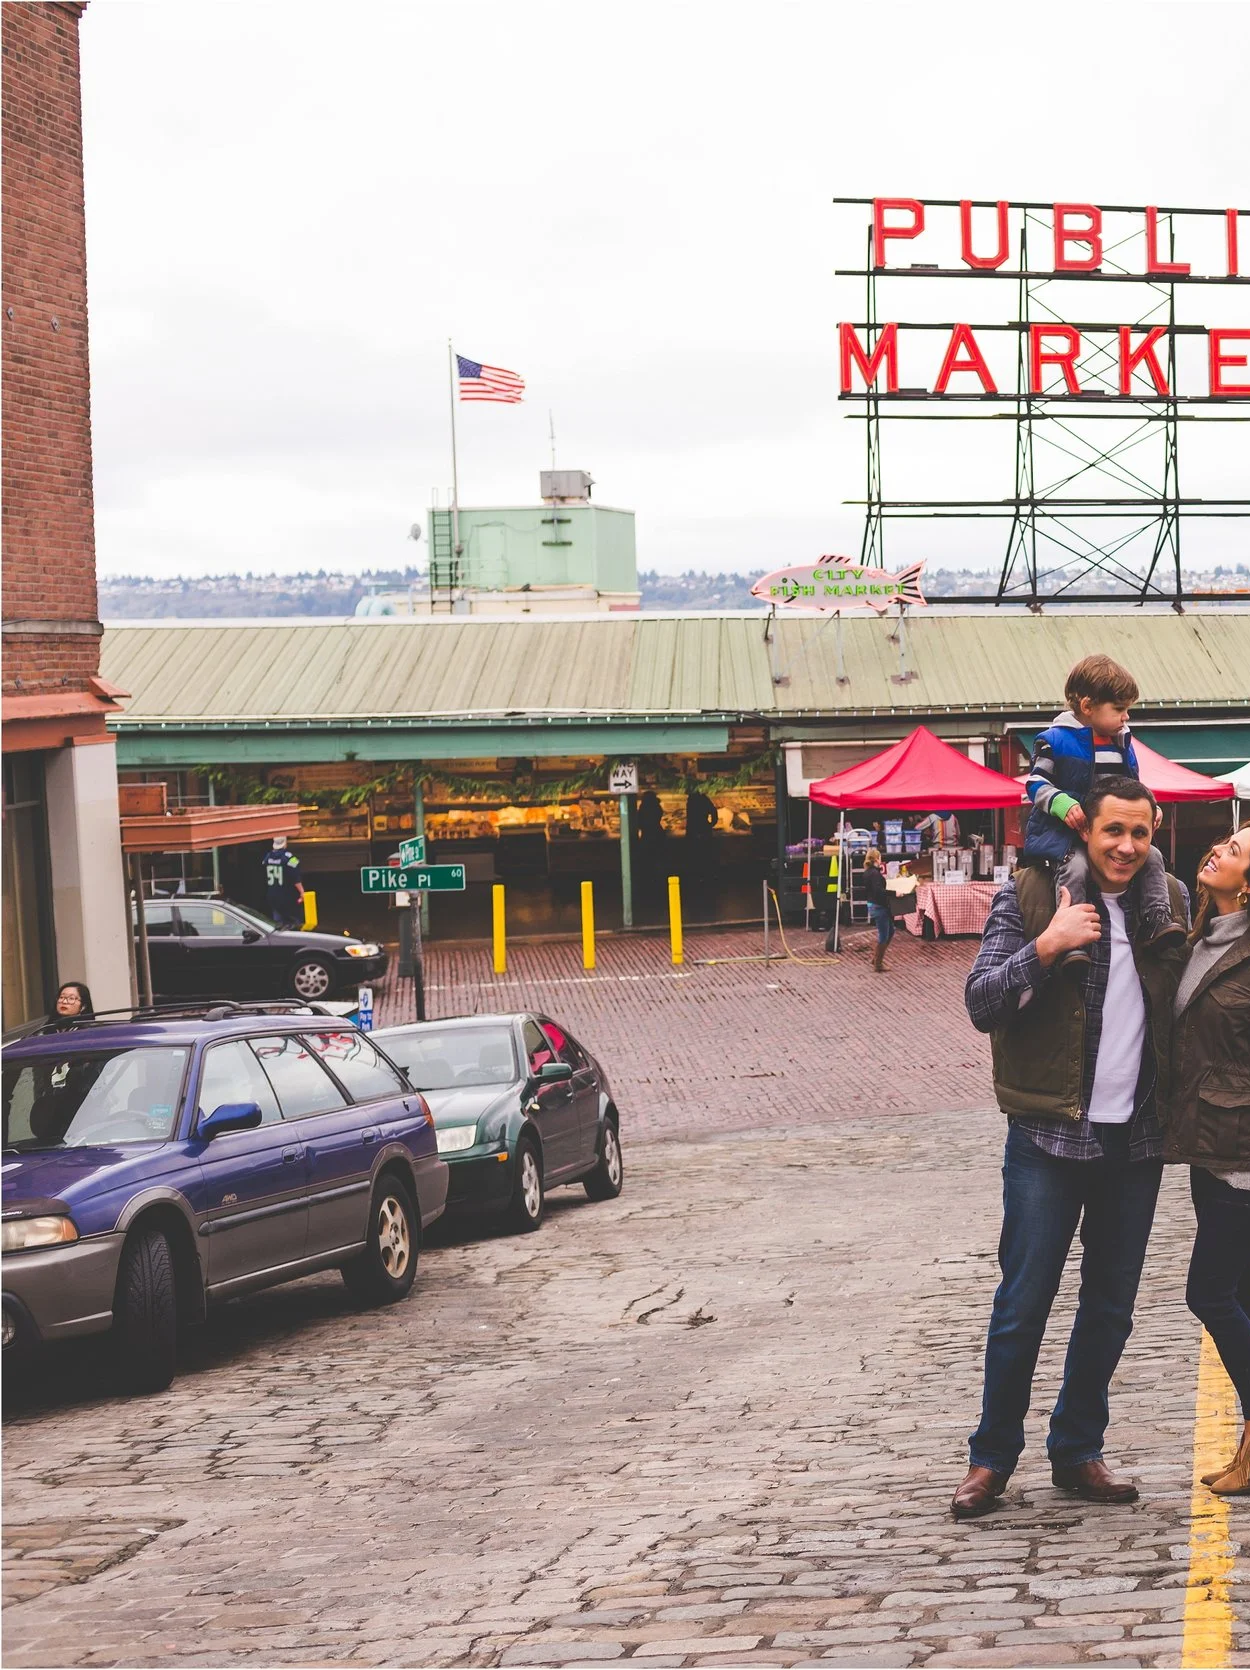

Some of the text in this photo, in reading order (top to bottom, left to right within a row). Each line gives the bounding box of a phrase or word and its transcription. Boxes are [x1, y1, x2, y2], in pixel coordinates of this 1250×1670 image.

[812, 569, 864, 580] CITY
[769, 584, 905, 597] FISH MARKET
[613, 769, 634, 778] WAY
[266, 865, 283, 886] 54
[368, 869, 462, 889] Pike Pl 60
